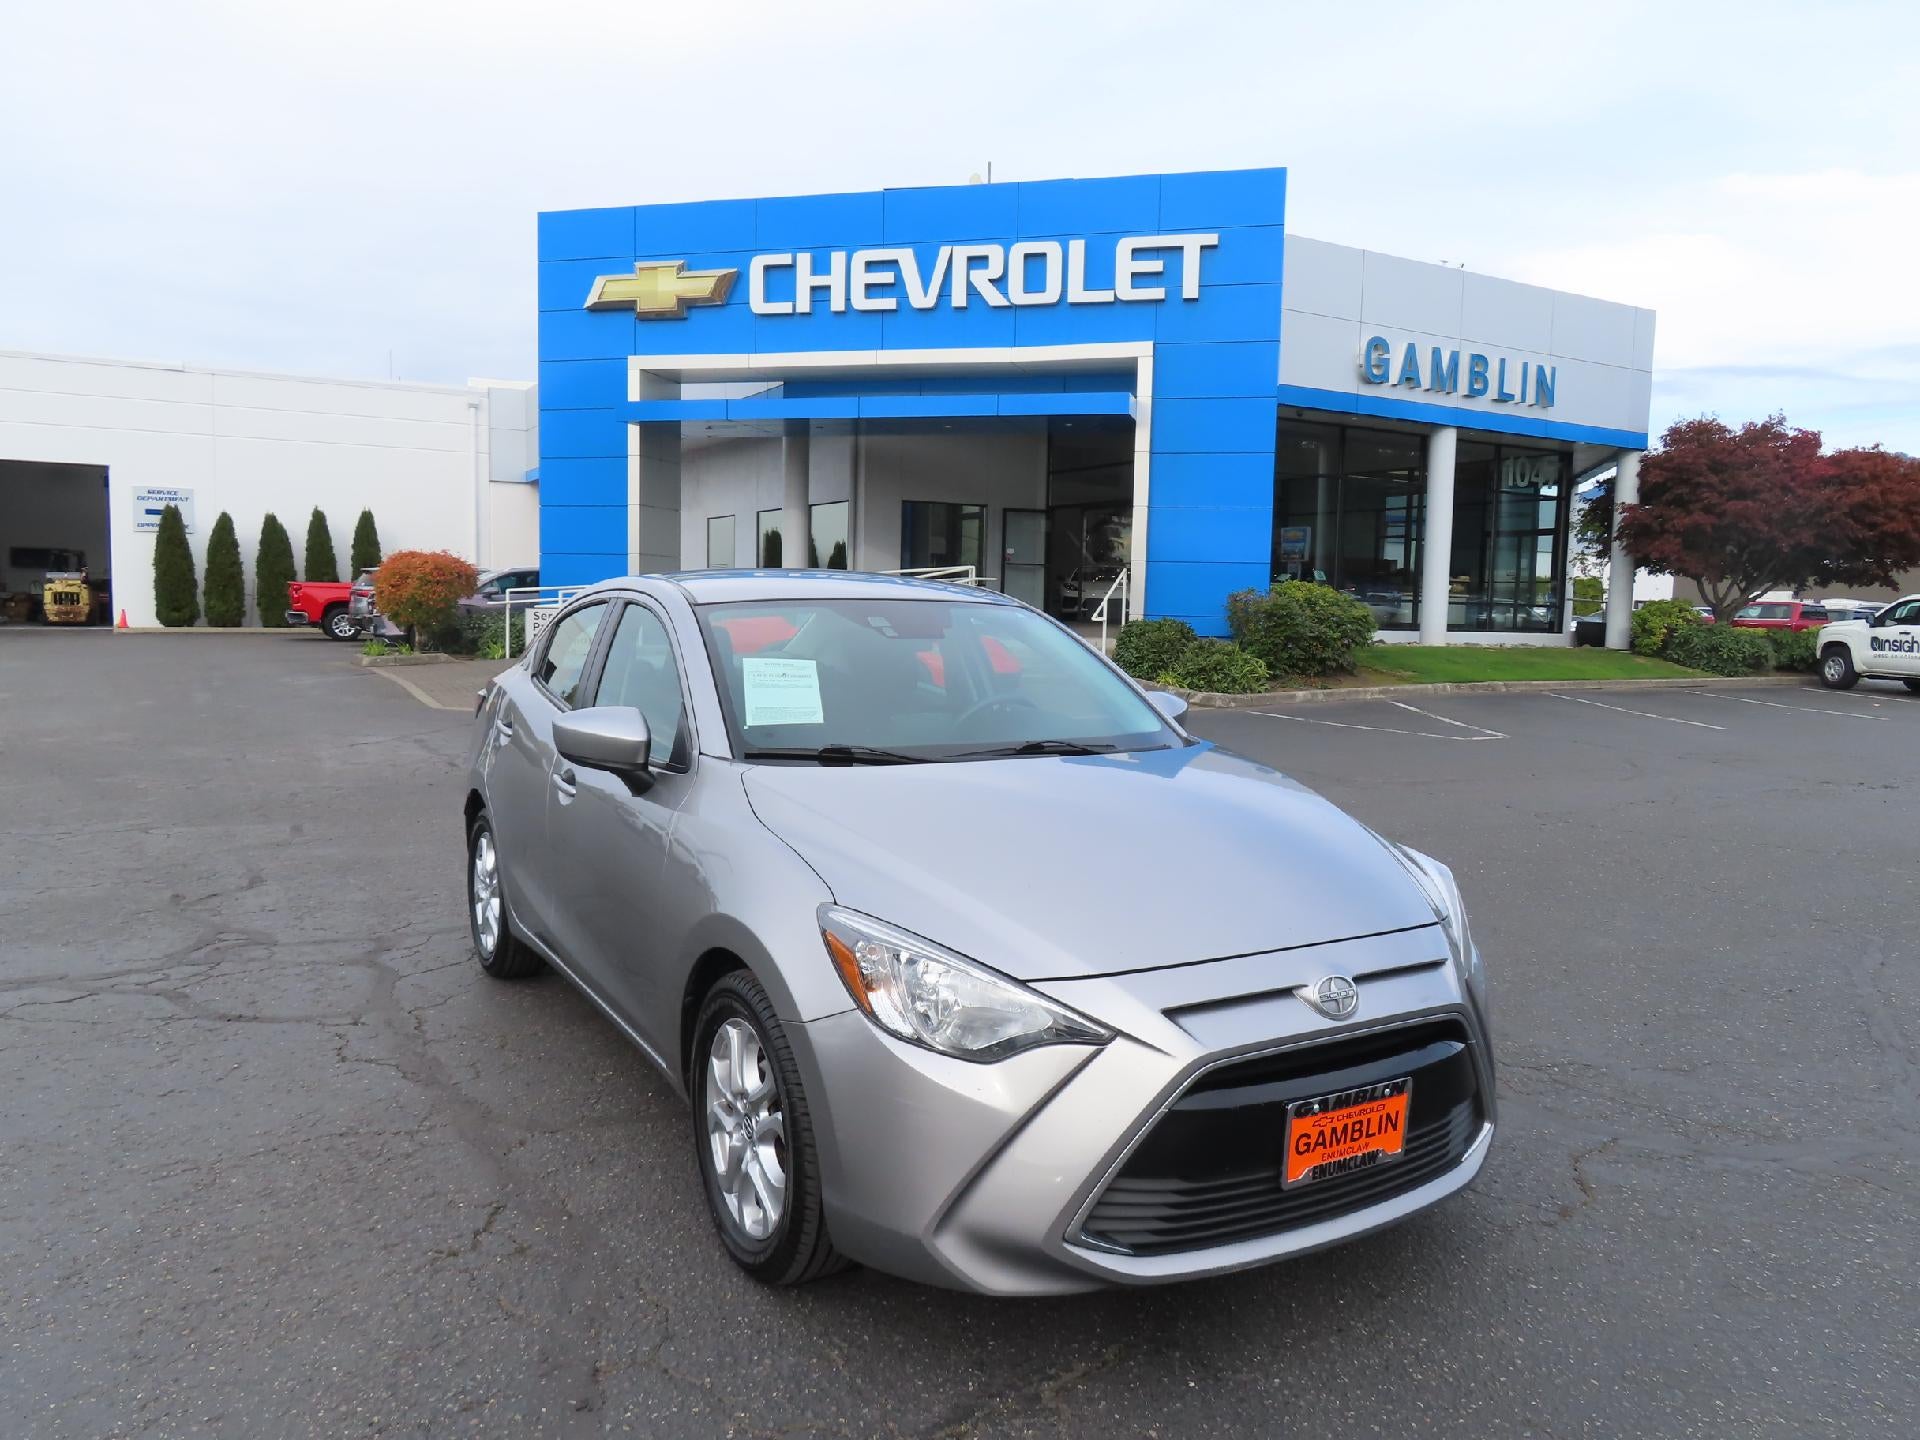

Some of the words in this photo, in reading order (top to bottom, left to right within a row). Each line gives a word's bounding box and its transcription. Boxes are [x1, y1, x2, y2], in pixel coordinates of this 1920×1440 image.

[749, 233, 1219, 315] CHEVROLET
[1363, 335, 1557, 408] GAMBLIN
[1295, 1110, 1400, 1156] GAMBLIN
[1321, 1141, 1370, 1162] ENUMCLAW
[1311, 1149, 1381, 1180] ENUMCLAW
